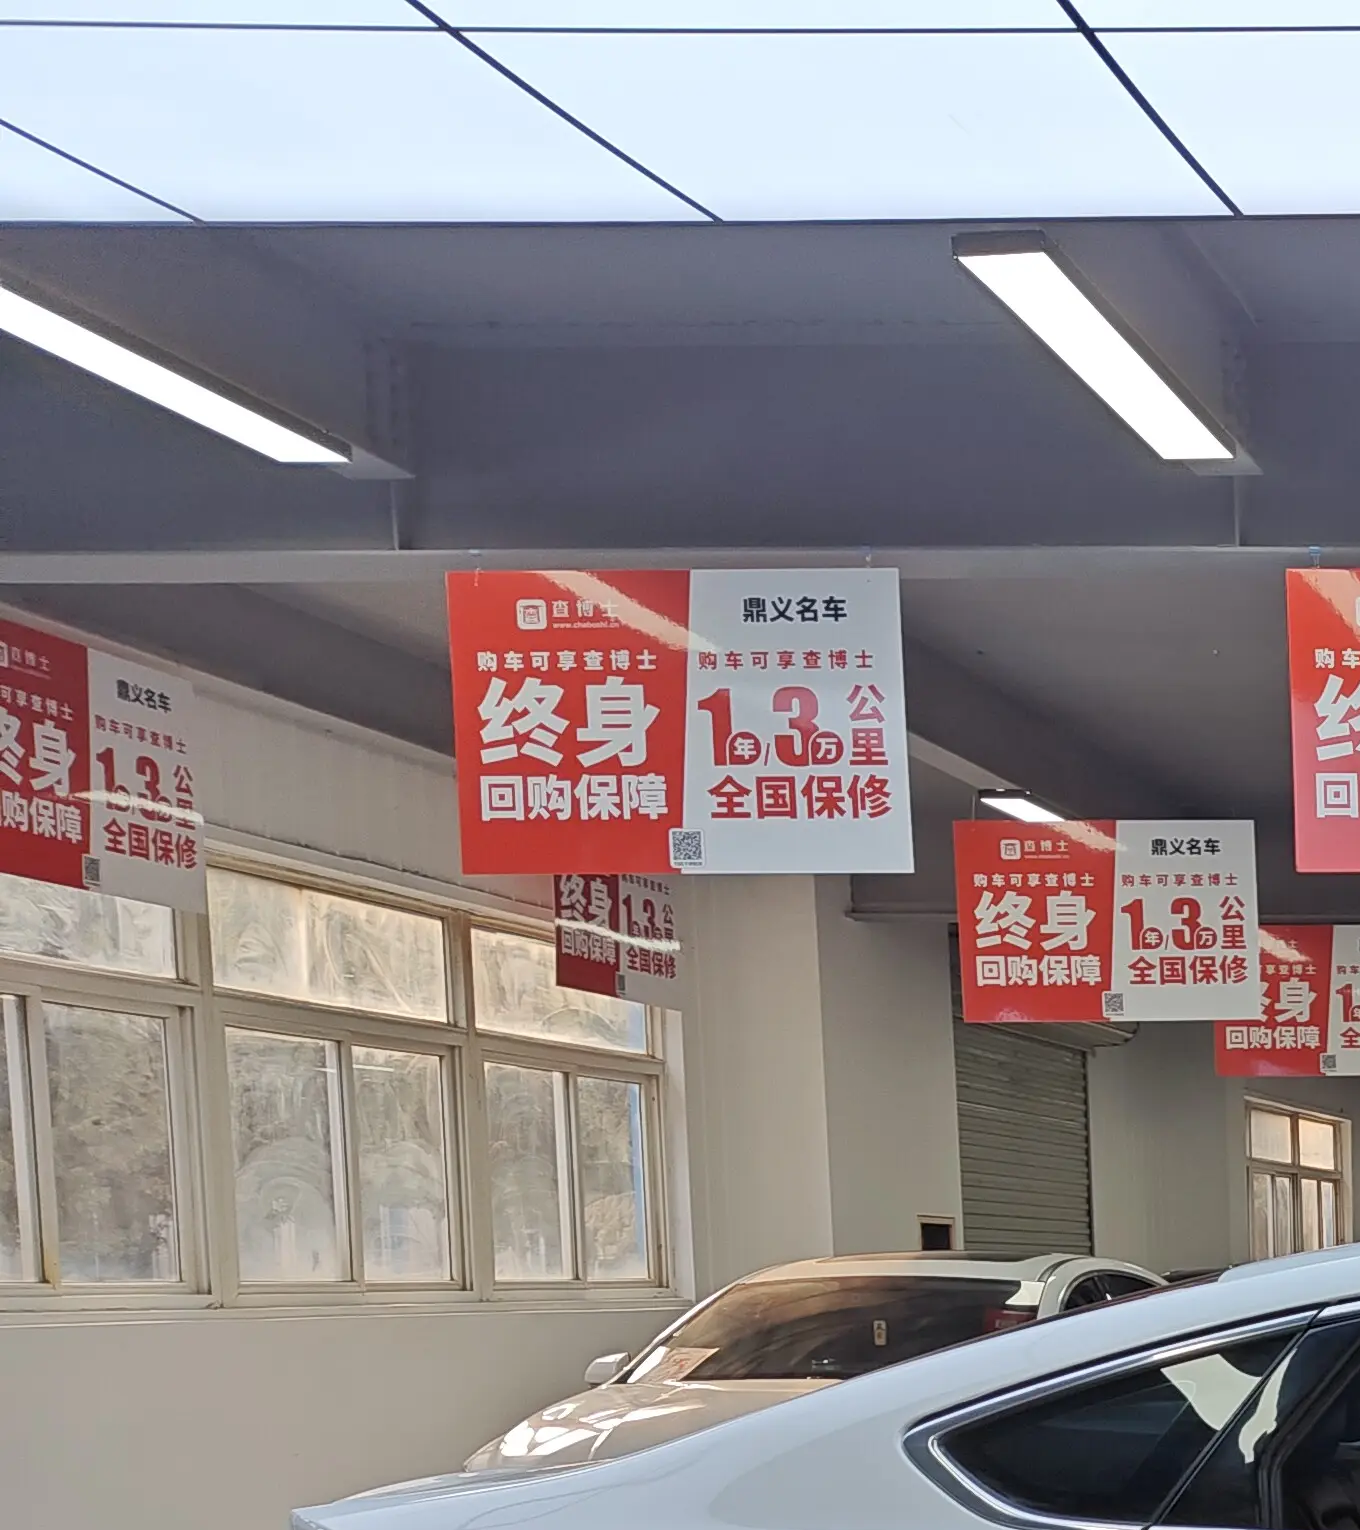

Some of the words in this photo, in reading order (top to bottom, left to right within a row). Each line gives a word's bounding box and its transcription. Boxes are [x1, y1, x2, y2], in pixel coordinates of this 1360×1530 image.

[742, 596, 847, 624] 鼎义名车
[477, 650, 657, 672] 购车可享查博士
[699, 650, 875, 671] 购车可享查博士
[117, 679, 172, 713] 鼎义名车
[478, 676, 661, 767] 终身
[480, 774, 669, 821] 回购保障
[708, 774, 892, 820] 全国保修
[0, 789, 83, 844] 购保障
[104, 818, 198, 870] 全国保修
[1151, 838, 1220, 856] 鼎义名车
[974, 873, 1095, 888] 购车可享查博士
[1121, 873, 1239, 887] 购车可享查博士
[974, 890, 1096, 951] 终身
[976, 955, 1102, 987] 回购保障
[1128, 955, 1248, 985] 全国保修
[1260, 964, 1317, 976] 享查博士
[1226, 1026, 1321, 1049] 回购保障
